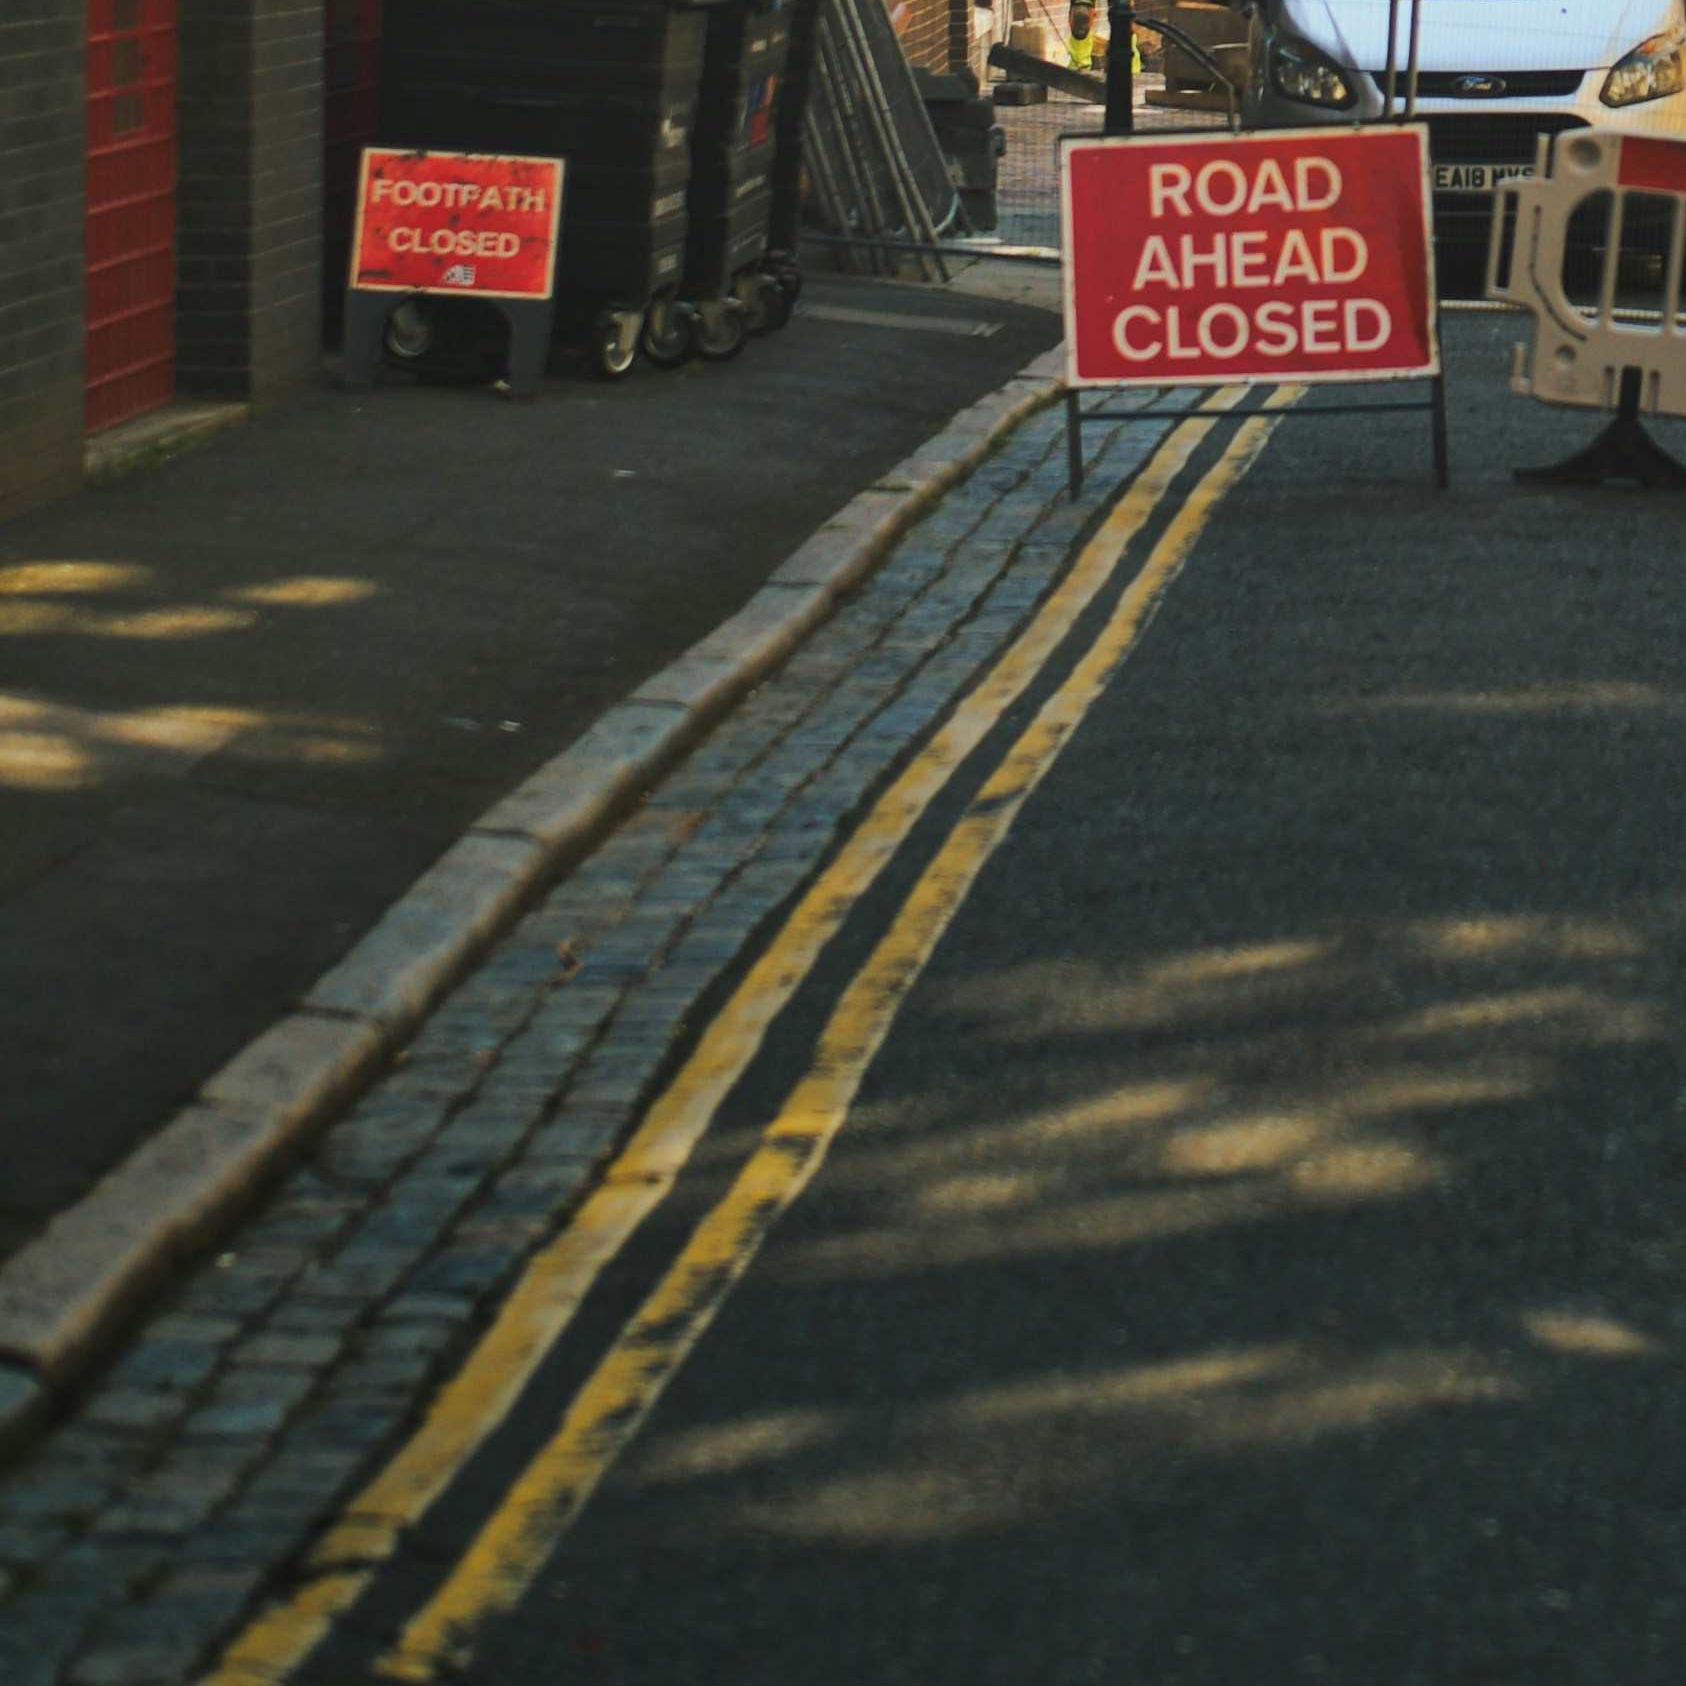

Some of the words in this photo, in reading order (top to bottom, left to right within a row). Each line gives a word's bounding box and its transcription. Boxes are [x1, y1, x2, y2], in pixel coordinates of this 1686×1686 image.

[370, 179, 546, 212] FOOTPATH
[1149, 156, 1342, 218] ROAD
[1435, 166, 1486, 188] EA18
[387, 226, 521, 258] CLOSED
[1132, 227, 1369, 291] AHEAD
[1112, 298, 1392, 360] CLOSED
